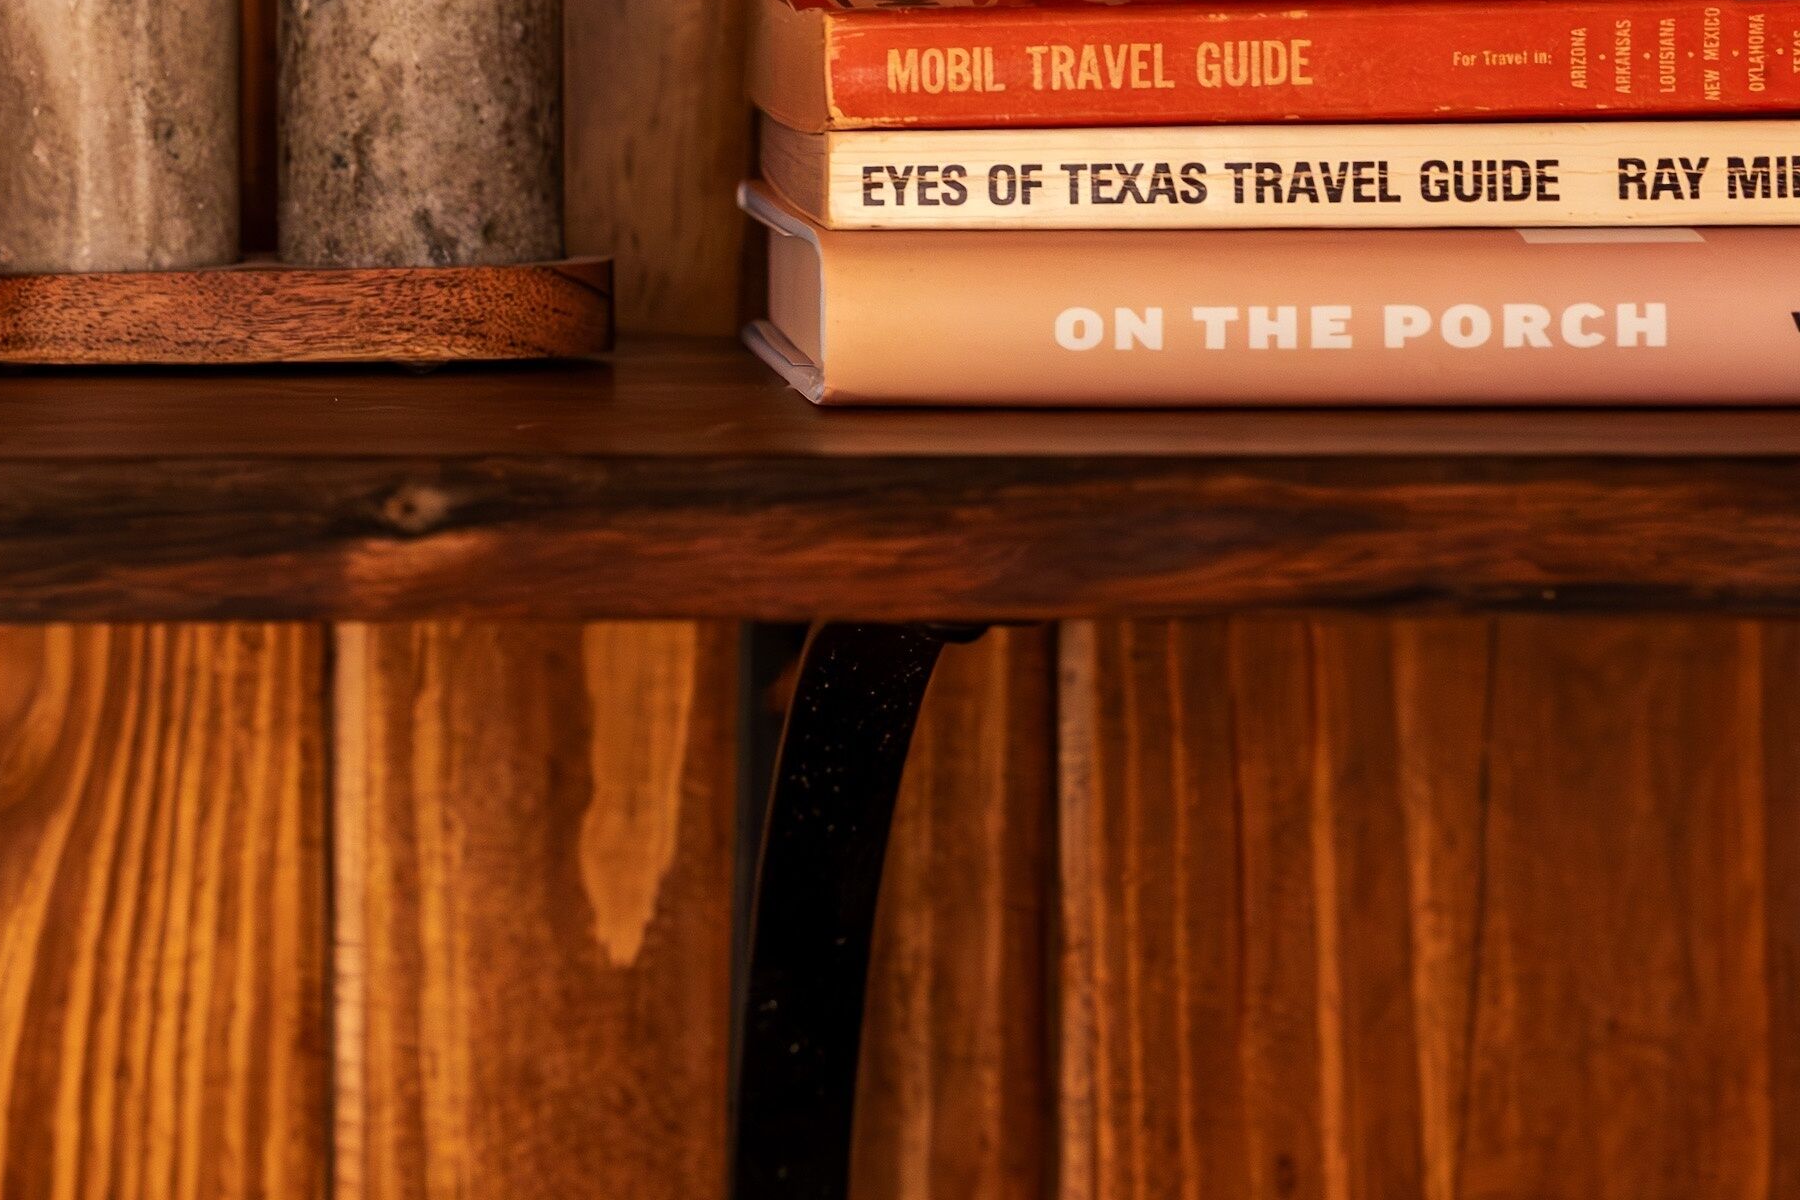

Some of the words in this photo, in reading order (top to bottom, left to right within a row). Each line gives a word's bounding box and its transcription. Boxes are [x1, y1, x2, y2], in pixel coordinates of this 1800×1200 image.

[1453, 51, 1477, 67] For
[1483, 50, 1528, 66] Travel
[1534, 51, 1552, 65] in:
[1570, 27, 1587, 90] ARIZONA
[1614, 19, 1632, 94] ARKANSAS
[1658, 18, 1676, 93] LOUISIANA
[1702, 7, 1721, 61] MEXICO
[1748, 13, 1766, 92] OKLAHOMA
[887, 47, 1006, 94] MOBIL
[1026, 42, 1176, 91] TRAVEL
[1196, 39, 1313, 88] GUIDE
[1703, 69, 1721, 101] NEW
[862, 164, 968, 207] EYES
[988, 163, 1043, 206] OF
[1060, 162, 1208, 205] TEXAS
[1225, 160, 1401, 204] TRAVEL
[1419, 159, 1560, 203] GUIDE
[1618, 157, 1710, 200] RAY
[1054, 306, 1164, 352] ON
[1193, 304, 1353, 350] THE
[1383, 302, 1668, 349] PORCH
